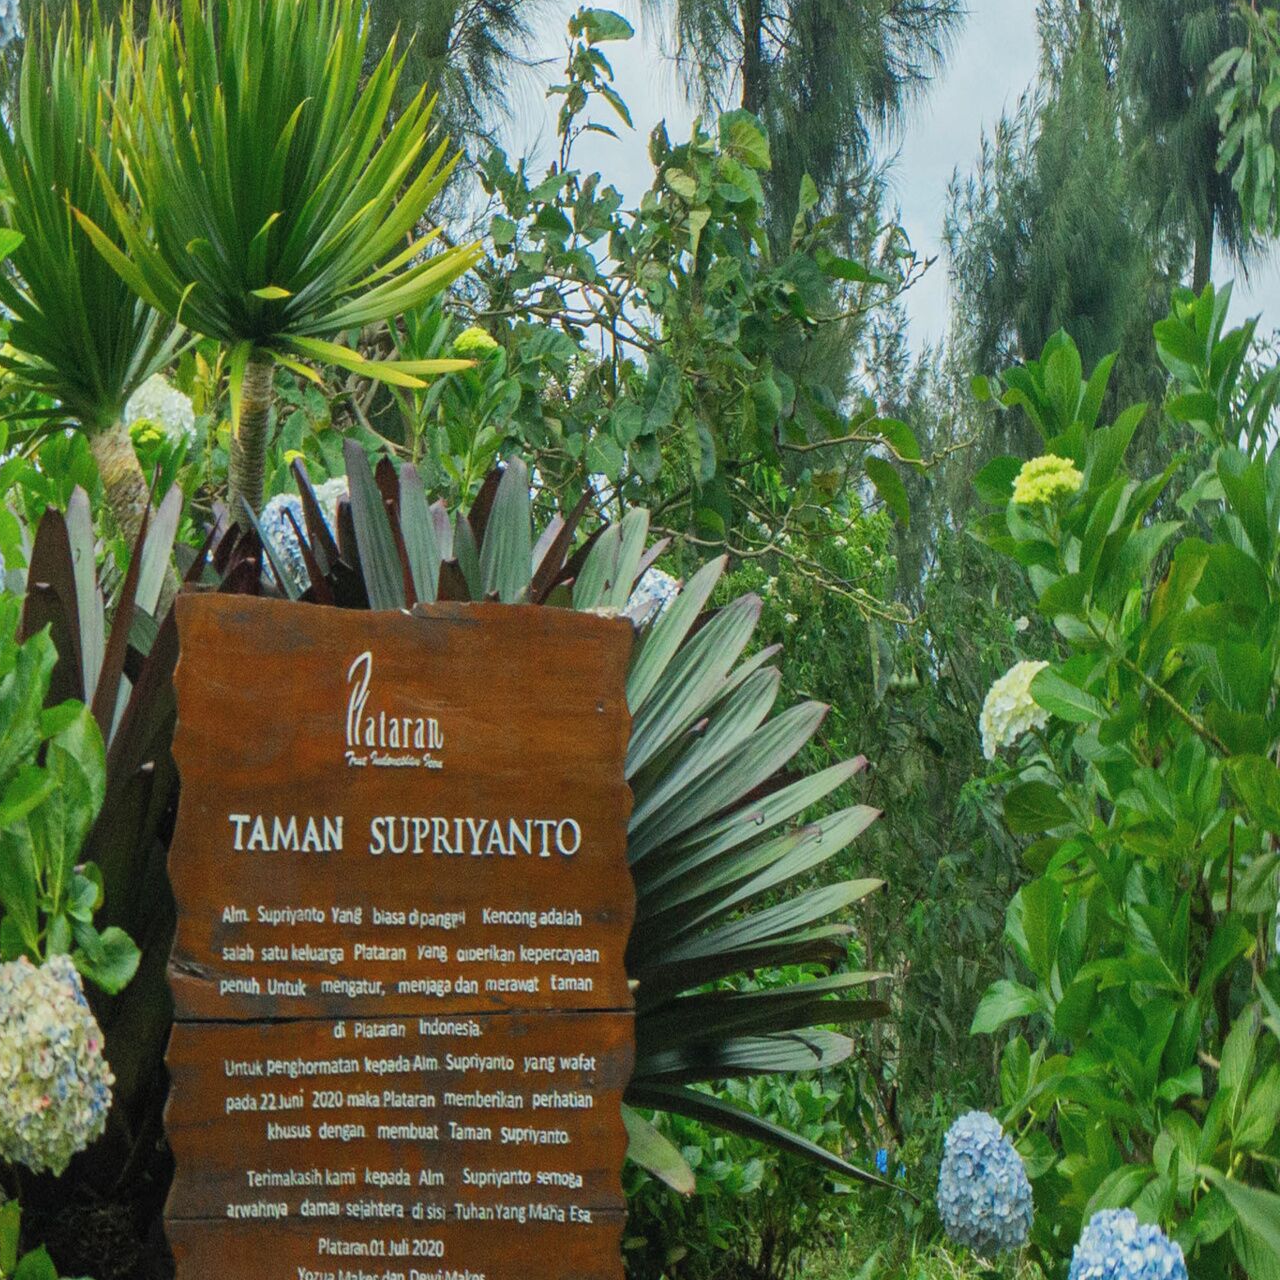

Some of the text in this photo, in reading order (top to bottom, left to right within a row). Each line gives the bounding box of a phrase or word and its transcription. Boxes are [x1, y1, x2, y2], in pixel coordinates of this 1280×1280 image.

[346, 650, 444, 749] Plataran
[228, 813, 582, 858] TAMAN SUPRIYANTO
[257, 905, 326, 926] Supriyanto
[331, 906, 362, 925] Yang
[372, 907, 406, 925] biasa
[482, 908, 537, 928] Kencong
[540, 907, 582, 926] adalah
[222, 943, 254, 961] salah
[261, 945, 288, 961] satu
[291, 943, 344, 965] keluarga
[354, 943, 407, 961] Plataran
[417, 944, 448, 963] yang
[519, 944, 600, 965] kepercayaan
[220, 974, 593, 998] penuh Untuk mengatur, menjaga dan merawat taman
[333, 1019, 483, 1039] di Plataran Indonesia.
[224, 1059, 263, 1076] Untuk
[266, 1057, 359, 1079] penghormatan
[364, 1055, 410, 1076] kepada
[445, 1053, 514, 1072] Supriyanto
[523, 1056, 555, 1073] yang
[560, 1053, 596, 1071] wafat
[225, 1088, 593, 1114] pada 22 Juni 2020 maka Plataran memberikan perhatian
[267, 1123, 311, 1141] khusus
[318, 1122, 365, 1141] dengan
[377, 1122, 439, 1140] membuat
[448, 1121, 491, 1140] Taman
[247, 1168, 322, 1187] Terimakasih
[325, 1167, 356, 1186] kami
[365, 1167, 411, 1188] kepada
[462, 1167, 532, 1188] Supriyanto
[536, 1170, 583, 1189] semoga
[226, 1200, 288, 1219] arwahnya
[346, 1199, 405, 1219] sejahtera
[412, 1202, 423, 1220] di
[426, 1203, 446, 1220] sisi
[454, 1202, 493, 1220] Tuhan
[495, 1204, 526, 1224] Yang
[369, 1239, 386, 1256] 01
[388, 1238, 410, 1257] Juli
[411, 1239, 445, 1258] 2020
